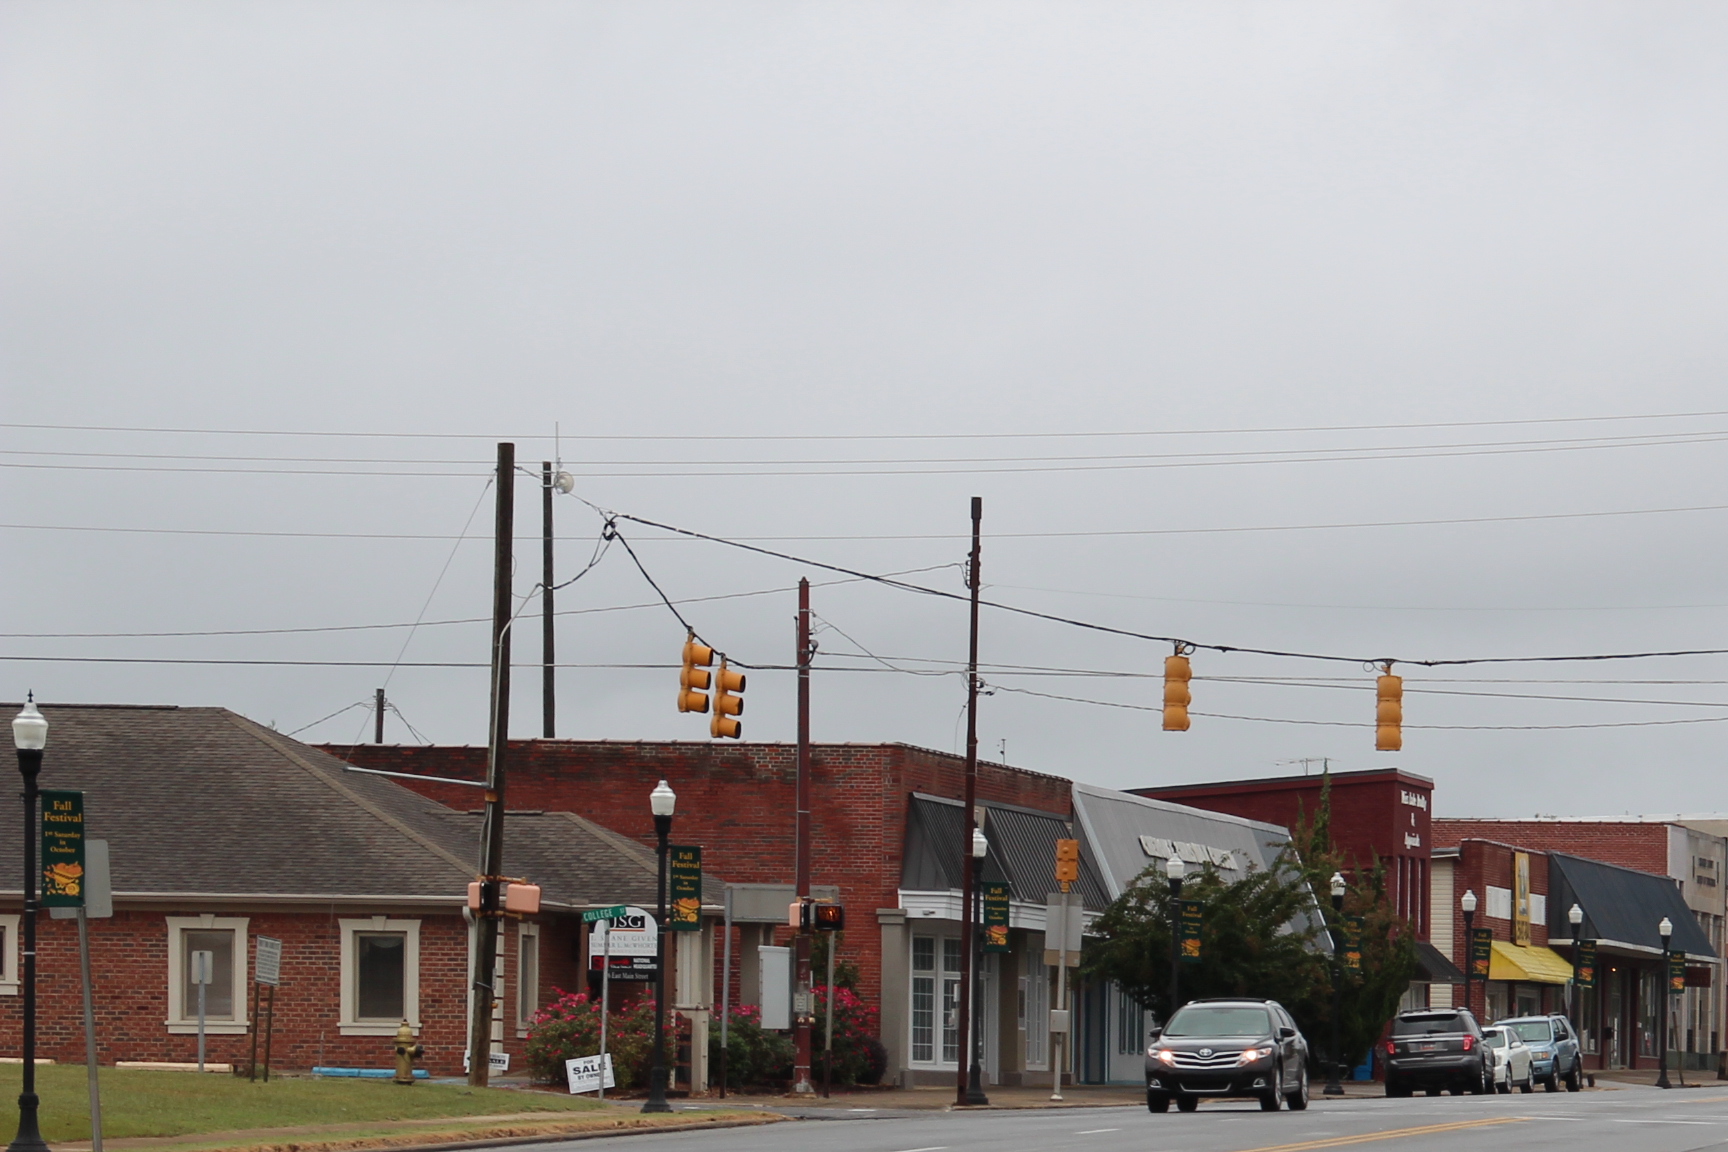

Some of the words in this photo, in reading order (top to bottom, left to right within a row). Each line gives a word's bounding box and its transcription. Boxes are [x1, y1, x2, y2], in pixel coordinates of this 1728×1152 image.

[53, 801, 72, 811] Fall
[44, 812, 82, 822] Festival
[54, 831, 81, 839] Saturday
[679, 852, 693, 860] Fall
[672, 861, 700, 869] Festival
[583, 909, 613, 921] COLLEGE
[613, 915, 641, 928] JSG
